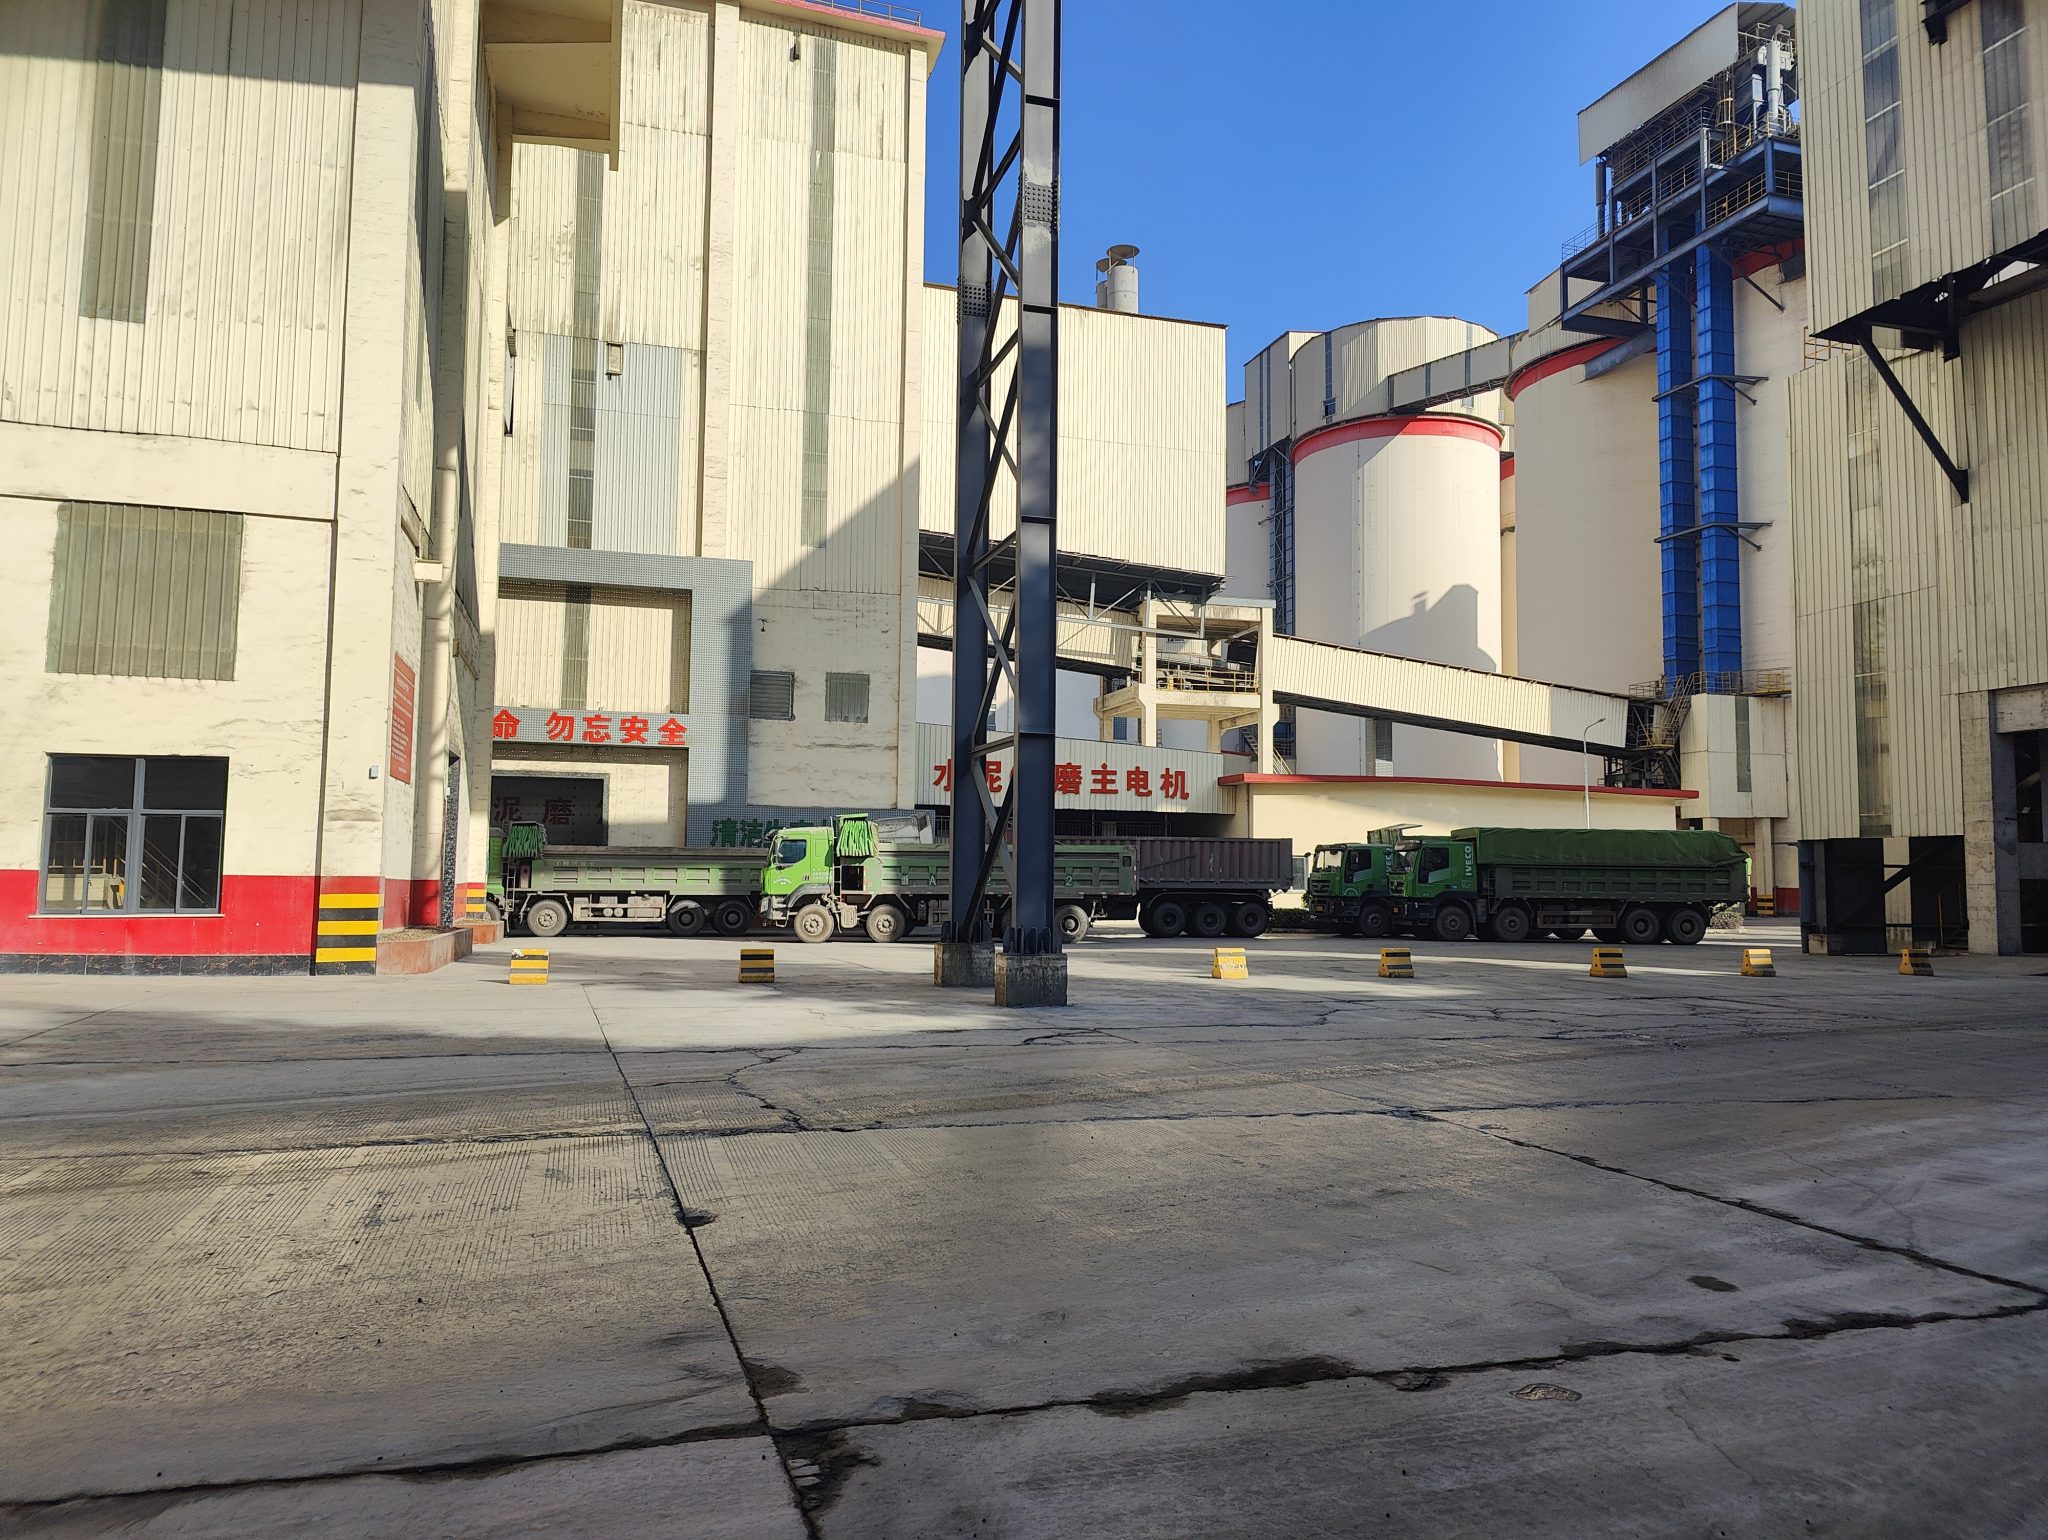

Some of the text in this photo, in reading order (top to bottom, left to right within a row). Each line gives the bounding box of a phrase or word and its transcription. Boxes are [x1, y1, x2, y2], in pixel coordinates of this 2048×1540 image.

[546, 711, 688, 746] 勿忘安全
[493, 796, 603, 825] 泥磨
[1464, 845, 1472, 876] IVECO
